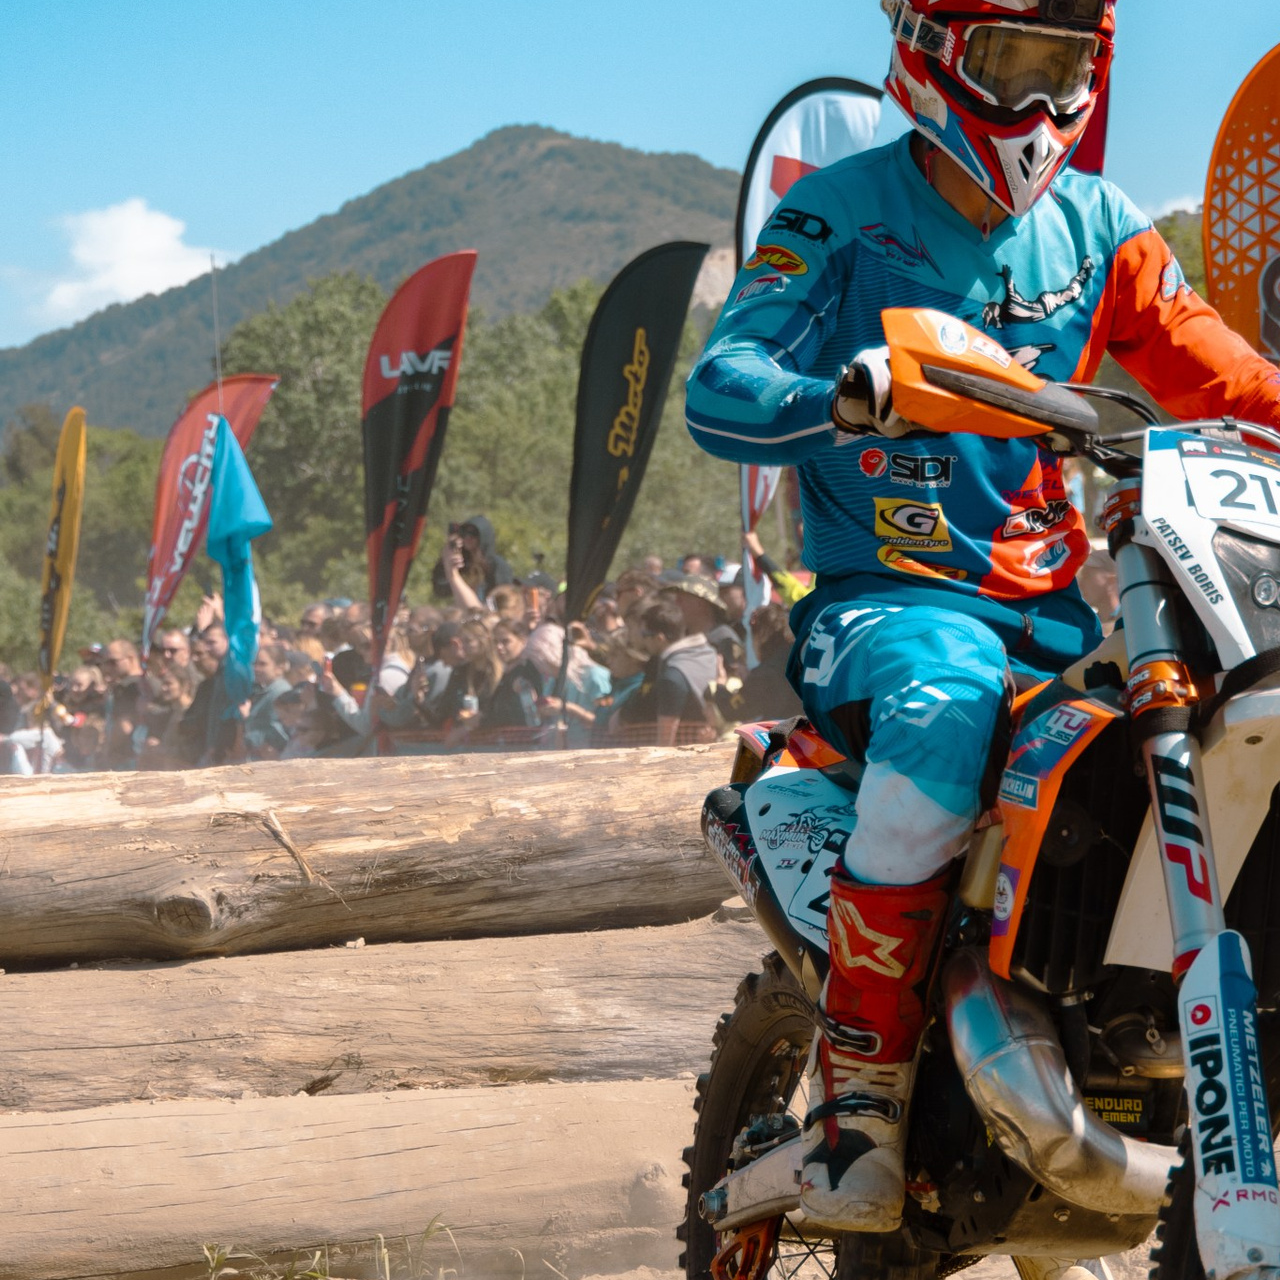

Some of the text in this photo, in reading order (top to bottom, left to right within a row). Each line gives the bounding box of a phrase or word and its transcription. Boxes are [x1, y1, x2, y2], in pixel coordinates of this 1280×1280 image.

[890, 453, 953, 482] SIDI
[878, 536, 950, 548] GoldenTyre
[1152, 517, 1225, 605] PATSEV BORIS
[759, 828, 809, 843] MAXIMUM
[1151, 754, 1214, 906] WP
[1227, 1008, 1255, 1177] PNEUMATICI PER MOTO
[1242, 1010, 1270, 1154] METZELER
[1085, 1097, 1143, 1111] ENDURO
[1096, 1112, 1142, 1123] EMENT
[1188, 1032, 1236, 1177] IPONE
[1236, 1188, 1278, 1205] RMG
